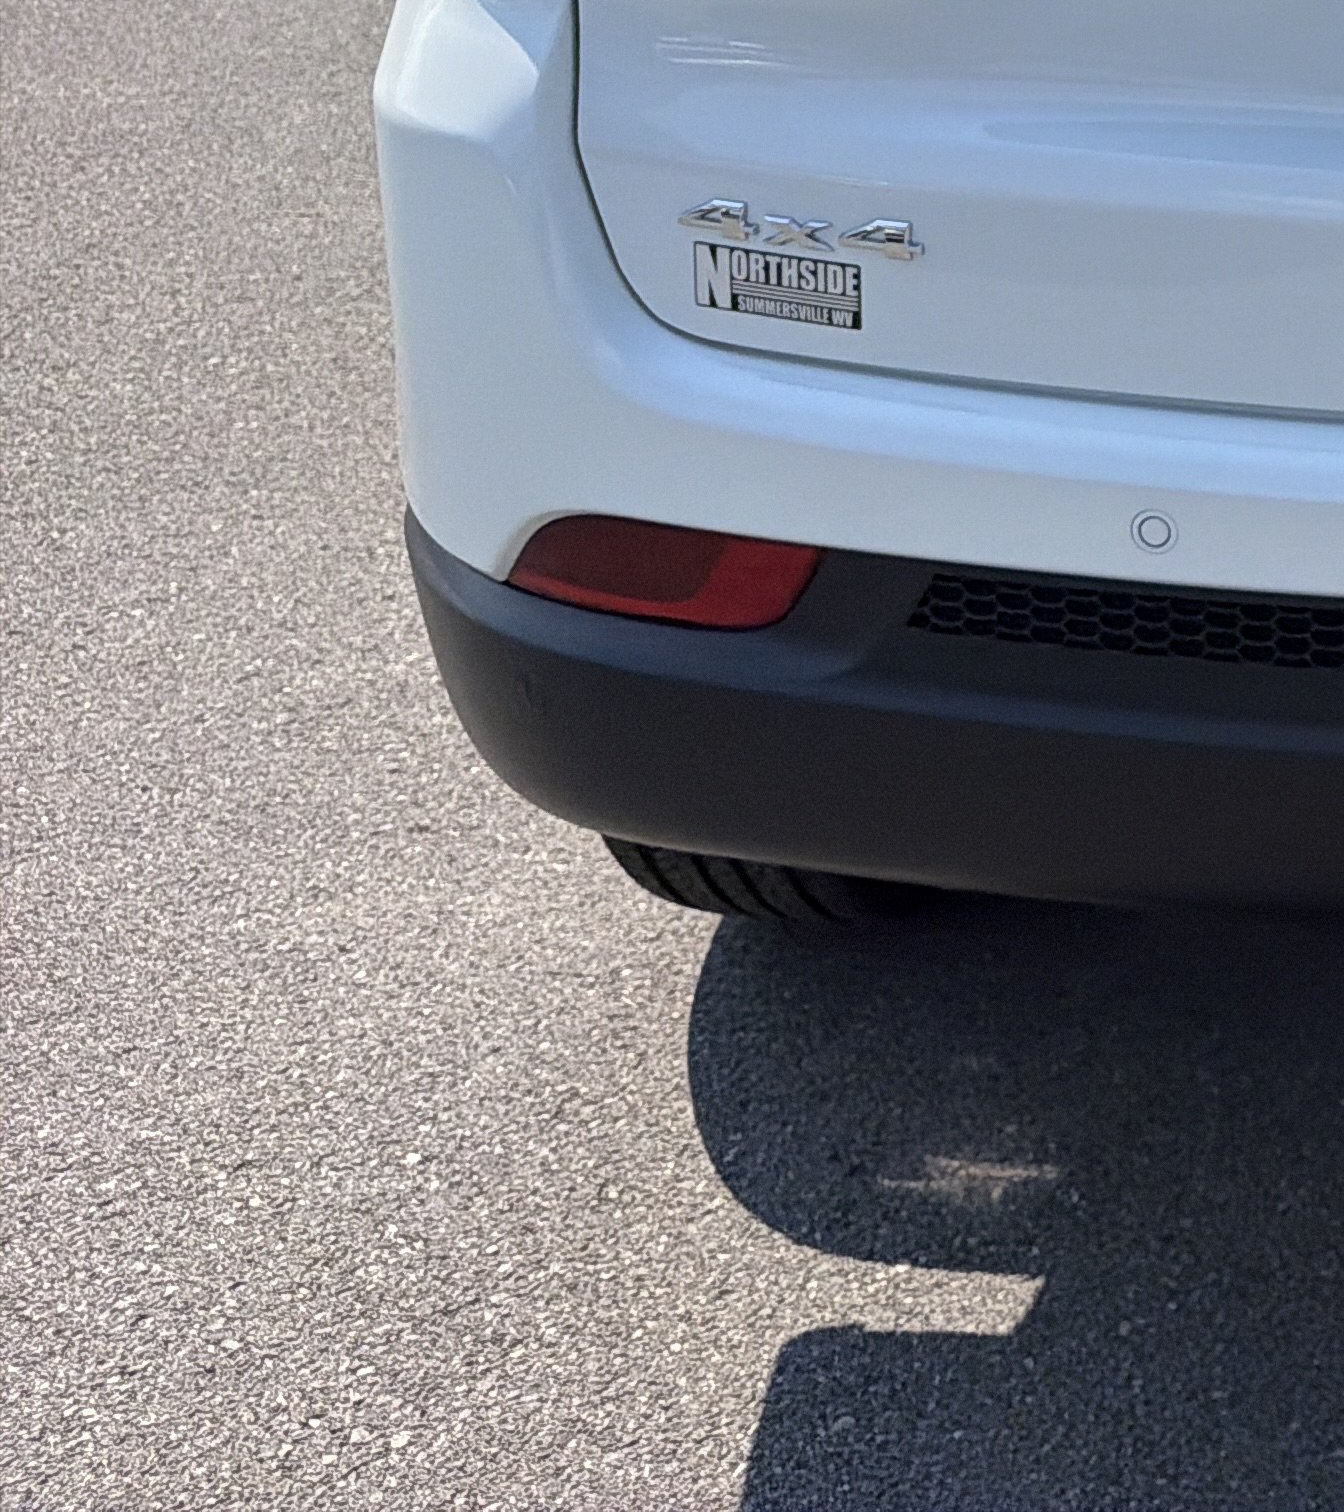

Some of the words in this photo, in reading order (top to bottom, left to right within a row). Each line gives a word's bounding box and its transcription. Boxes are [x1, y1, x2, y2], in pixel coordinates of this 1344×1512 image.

[696, 243, 860, 309] NORTHSIDE
[737, 295, 830, 325] SUMMERSVILLE
[831, 309, 855, 328] WV
